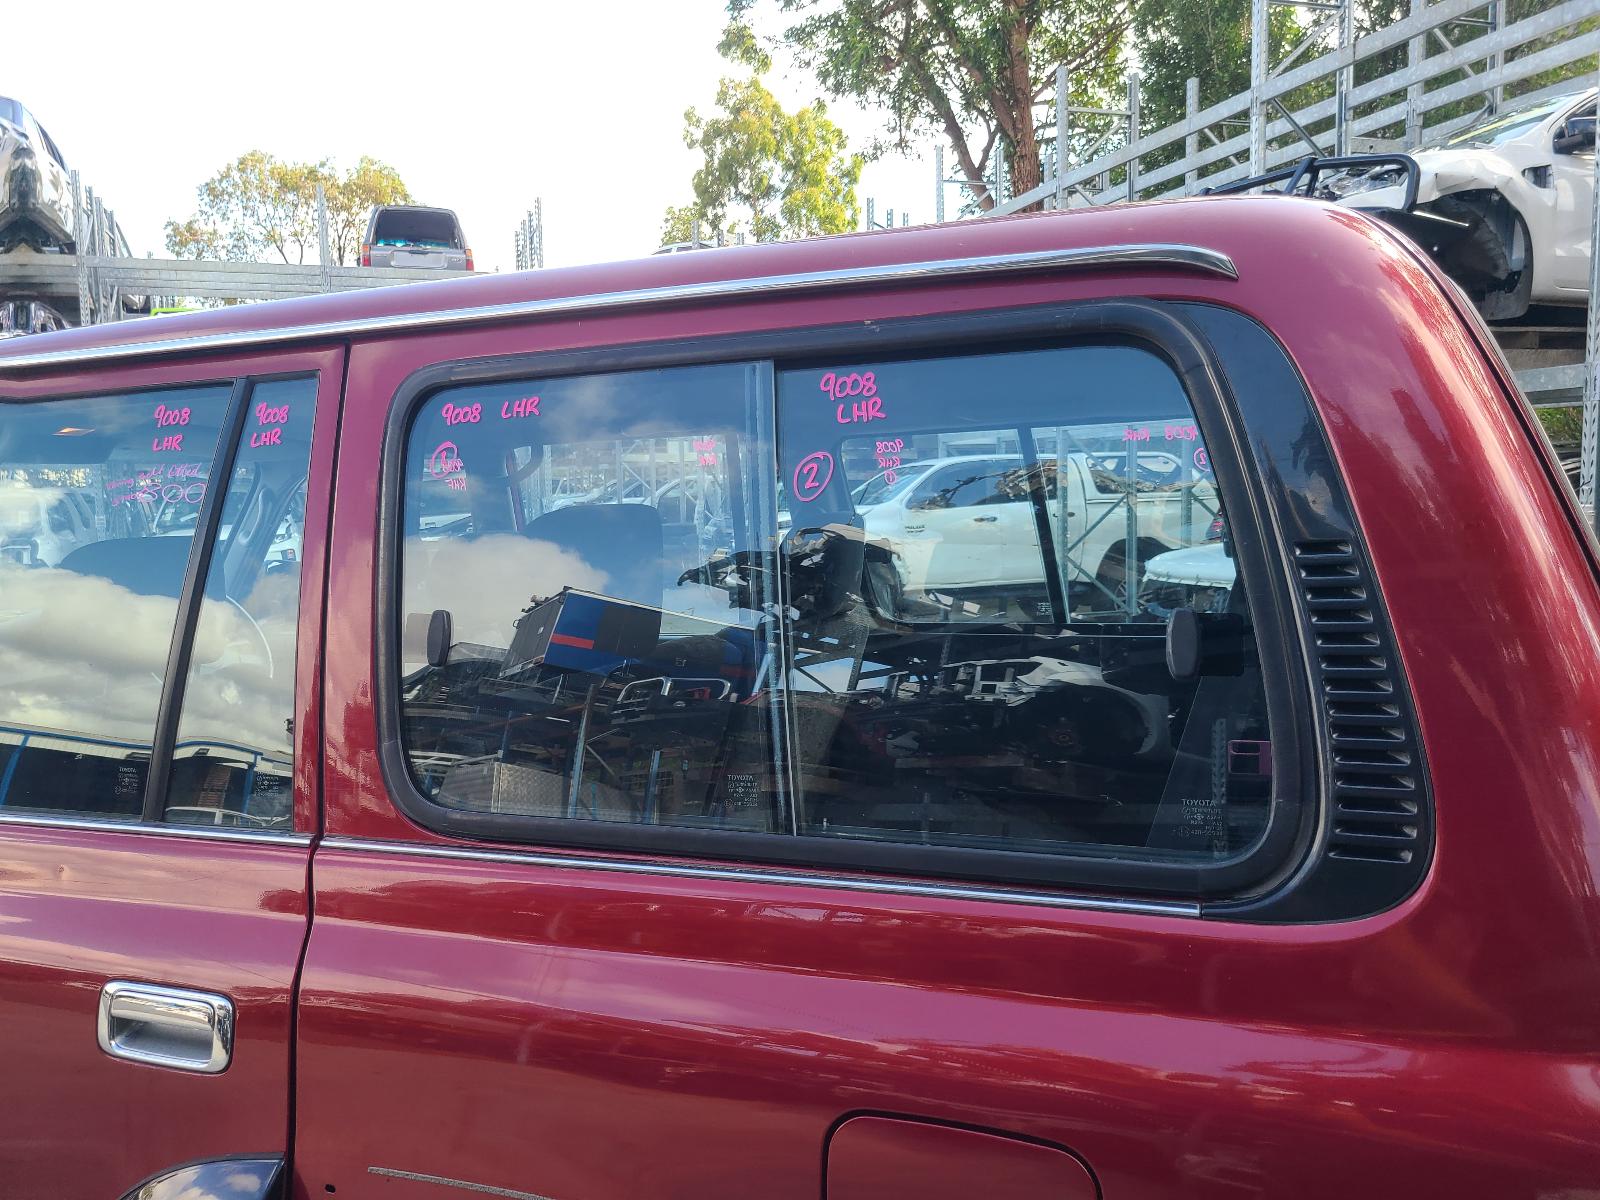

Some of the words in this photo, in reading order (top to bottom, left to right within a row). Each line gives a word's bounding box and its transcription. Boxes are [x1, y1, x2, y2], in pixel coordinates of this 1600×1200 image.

[819, 371, 878, 401] 9008
[153, 404, 191, 427] 9008
[255, 401, 290, 425] 9008
[441, 402, 483, 426] 9008
[500, 396, 541, 419] LHR
[835, 396, 887, 424] LHR
[152, 433, 184, 452] LHR
[250, 427, 282, 448] LHR
[1181, 798, 1217, 807] TOYOTA
